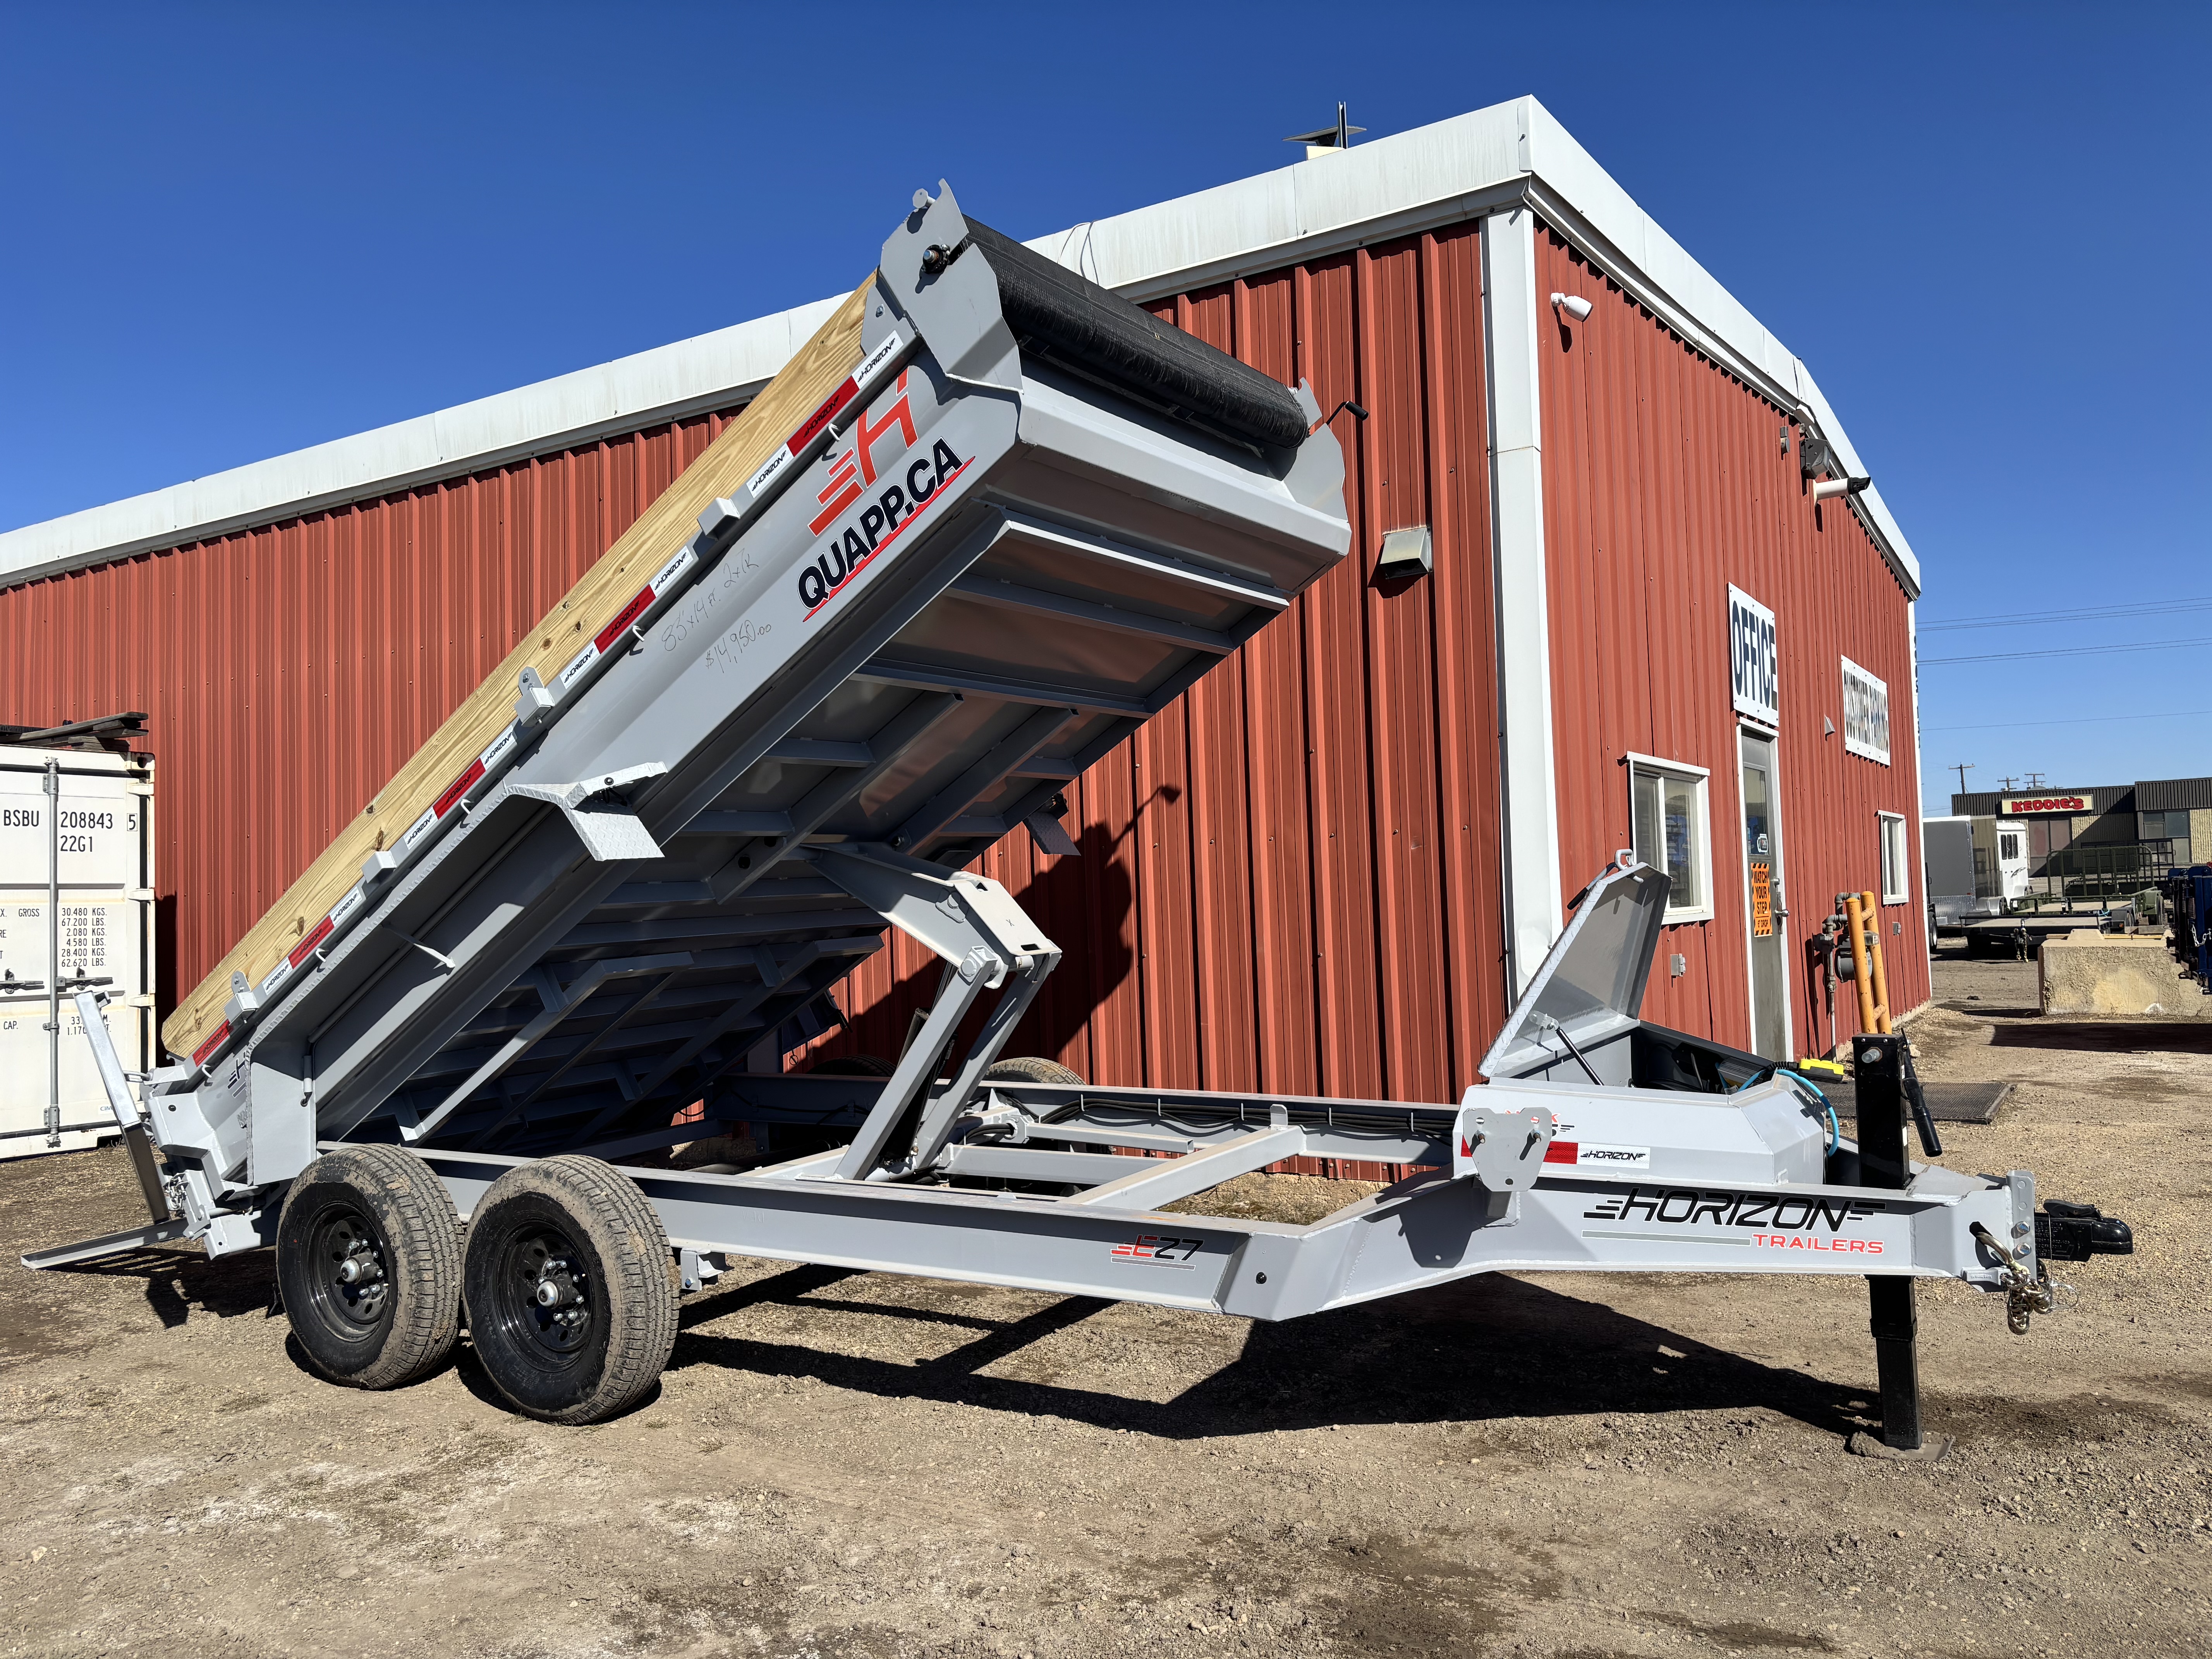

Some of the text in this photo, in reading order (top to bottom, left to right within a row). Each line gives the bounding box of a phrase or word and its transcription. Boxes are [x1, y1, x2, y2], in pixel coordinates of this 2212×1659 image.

[860, 342, 894, 381] HORIZON
[805, 398, 838, 436] HORIZON
[754, 453, 785, 490] HORIZON
[797, 436, 964, 610] QUAPP.CA
[656, 555, 685, 587] HORIZON
[611, 603, 638, 634] HORIZON
[566, 651, 592, 682] HORIZON
[1732, 600, 1778, 712] OFFICE
[1844, 668, 1871, 746] CUSTOMER
[1869, 684, 1889, 754] PARKING
[486, 735, 511, 763] HORIZON
[447, 776, 470, 803] HORIZON
[2011, 796, 2084, 812] KEDDIE'S
[3, 809, 136, 830] BSBU 208843 5
[409, 816, 431, 843] HORIZON
[60, 835, 93, 852] 22G1
[1753, 871, 1768, 884] WATCH
[1755, 886, 1767, 899] YOUR
[19, 908, 40, 917] GROSS
[62, 908, 88, 916] 30.480
[92, 908, 107, 916] KGS.
[334, 895, 356, 920] HORIZON
[1757, 901, 1767, 915] STEP
[62, 918, 106, 926] 67.200 LBS.
[67, 928, 87, 936] 2.080
[92, 928, 107, 936] KGS.
[62, 948, 87, 957] 28.400
[92, 948, 107, 956] KGS.
[66, 938, 106, 946] 4.580 LBS.
[62, 958, 106, 967] 62.620 LBS.
[266, 965, 288, 989] HORIZON
[3, 1020, 19, 1030] CAP.
[1586, 1149, 1640, 1161] HORIZON
[1615, 1187, 1855, 1233] HORIZON
[1131, 1234, 1204, 1261] E27
[1752, 1234, 1885, 1254] TRAILERS
